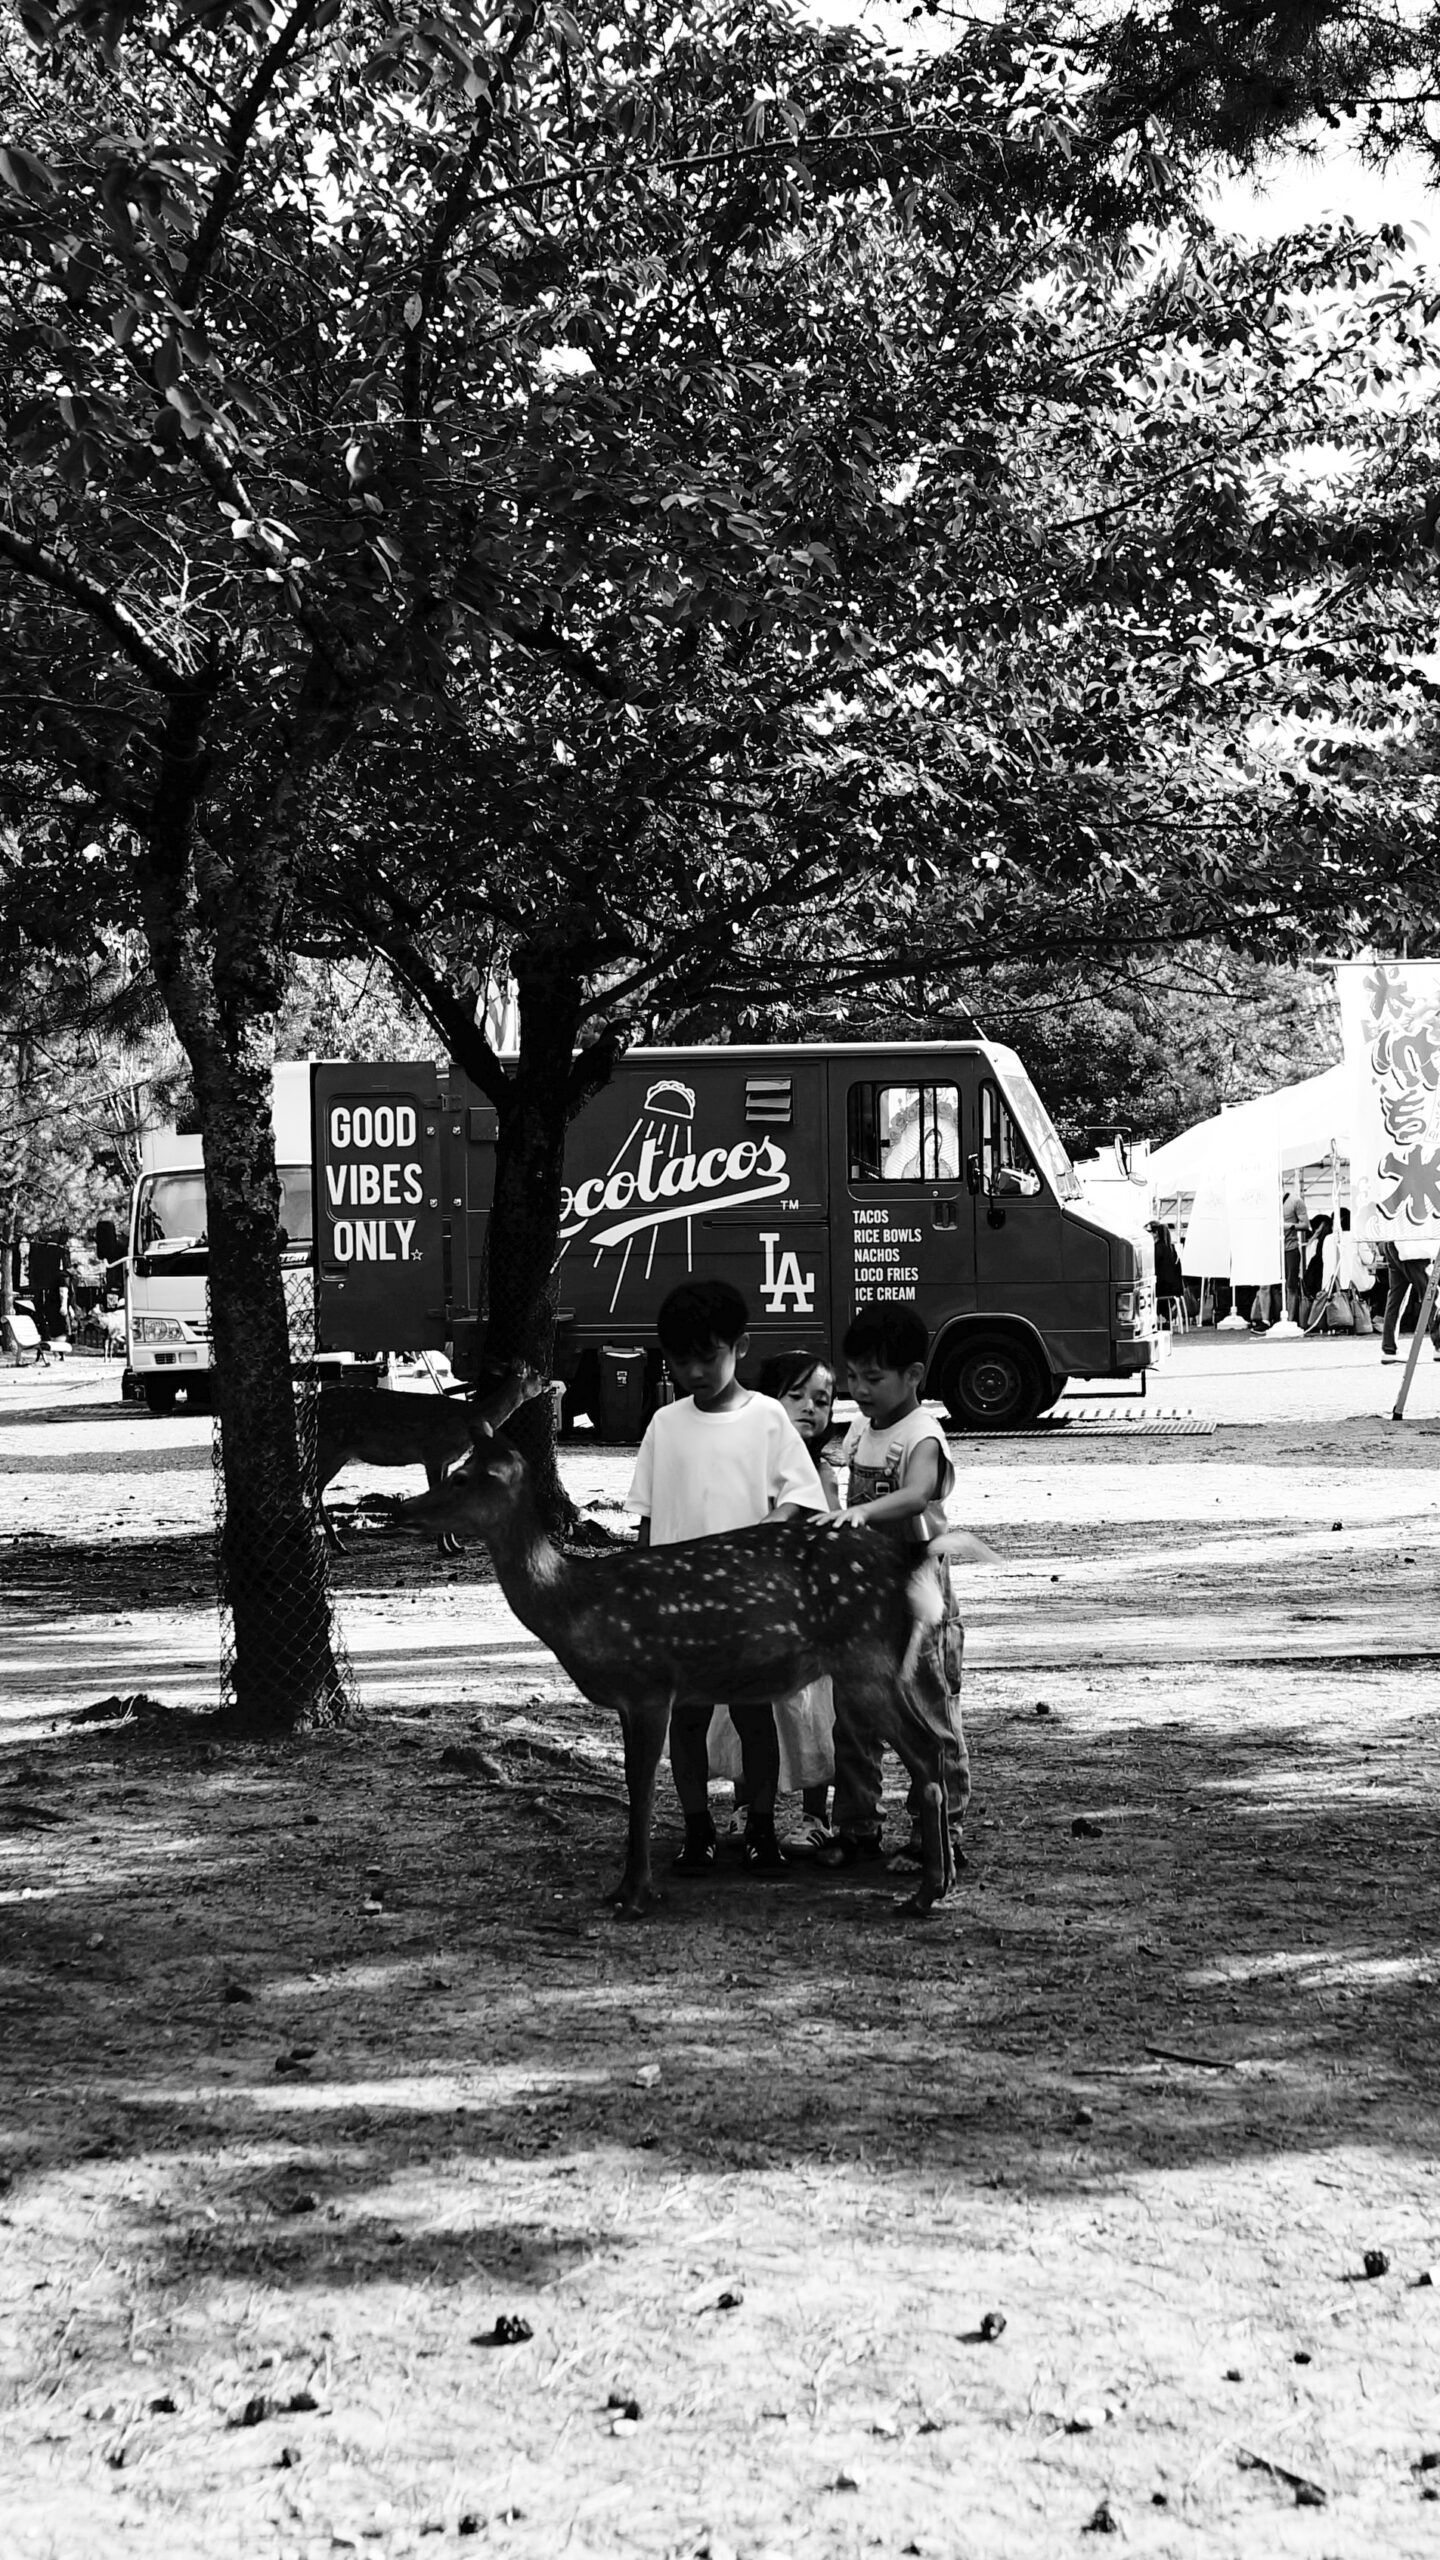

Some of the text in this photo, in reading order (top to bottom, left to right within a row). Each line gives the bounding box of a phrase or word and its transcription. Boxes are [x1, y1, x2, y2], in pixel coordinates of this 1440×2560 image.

[331, 1106, 416, 1148] GOOD
[325, 1163, 423, 1205] VIBES
[780, 1200, 799, 1210] TM
[852, 1209, 889, 1224] TACOS
[333, 1220, 416, 1261] ONLY
[853, 1228, 922, 1243] RICE BOWLS
[854, 1248, 900, 1263] NACHOS
[759, 1232, 815, 1313] LA
[854, 1267, 919, 1282] LOCO FRIES
[855, 1286, 916, 1301] ICE CREAM
